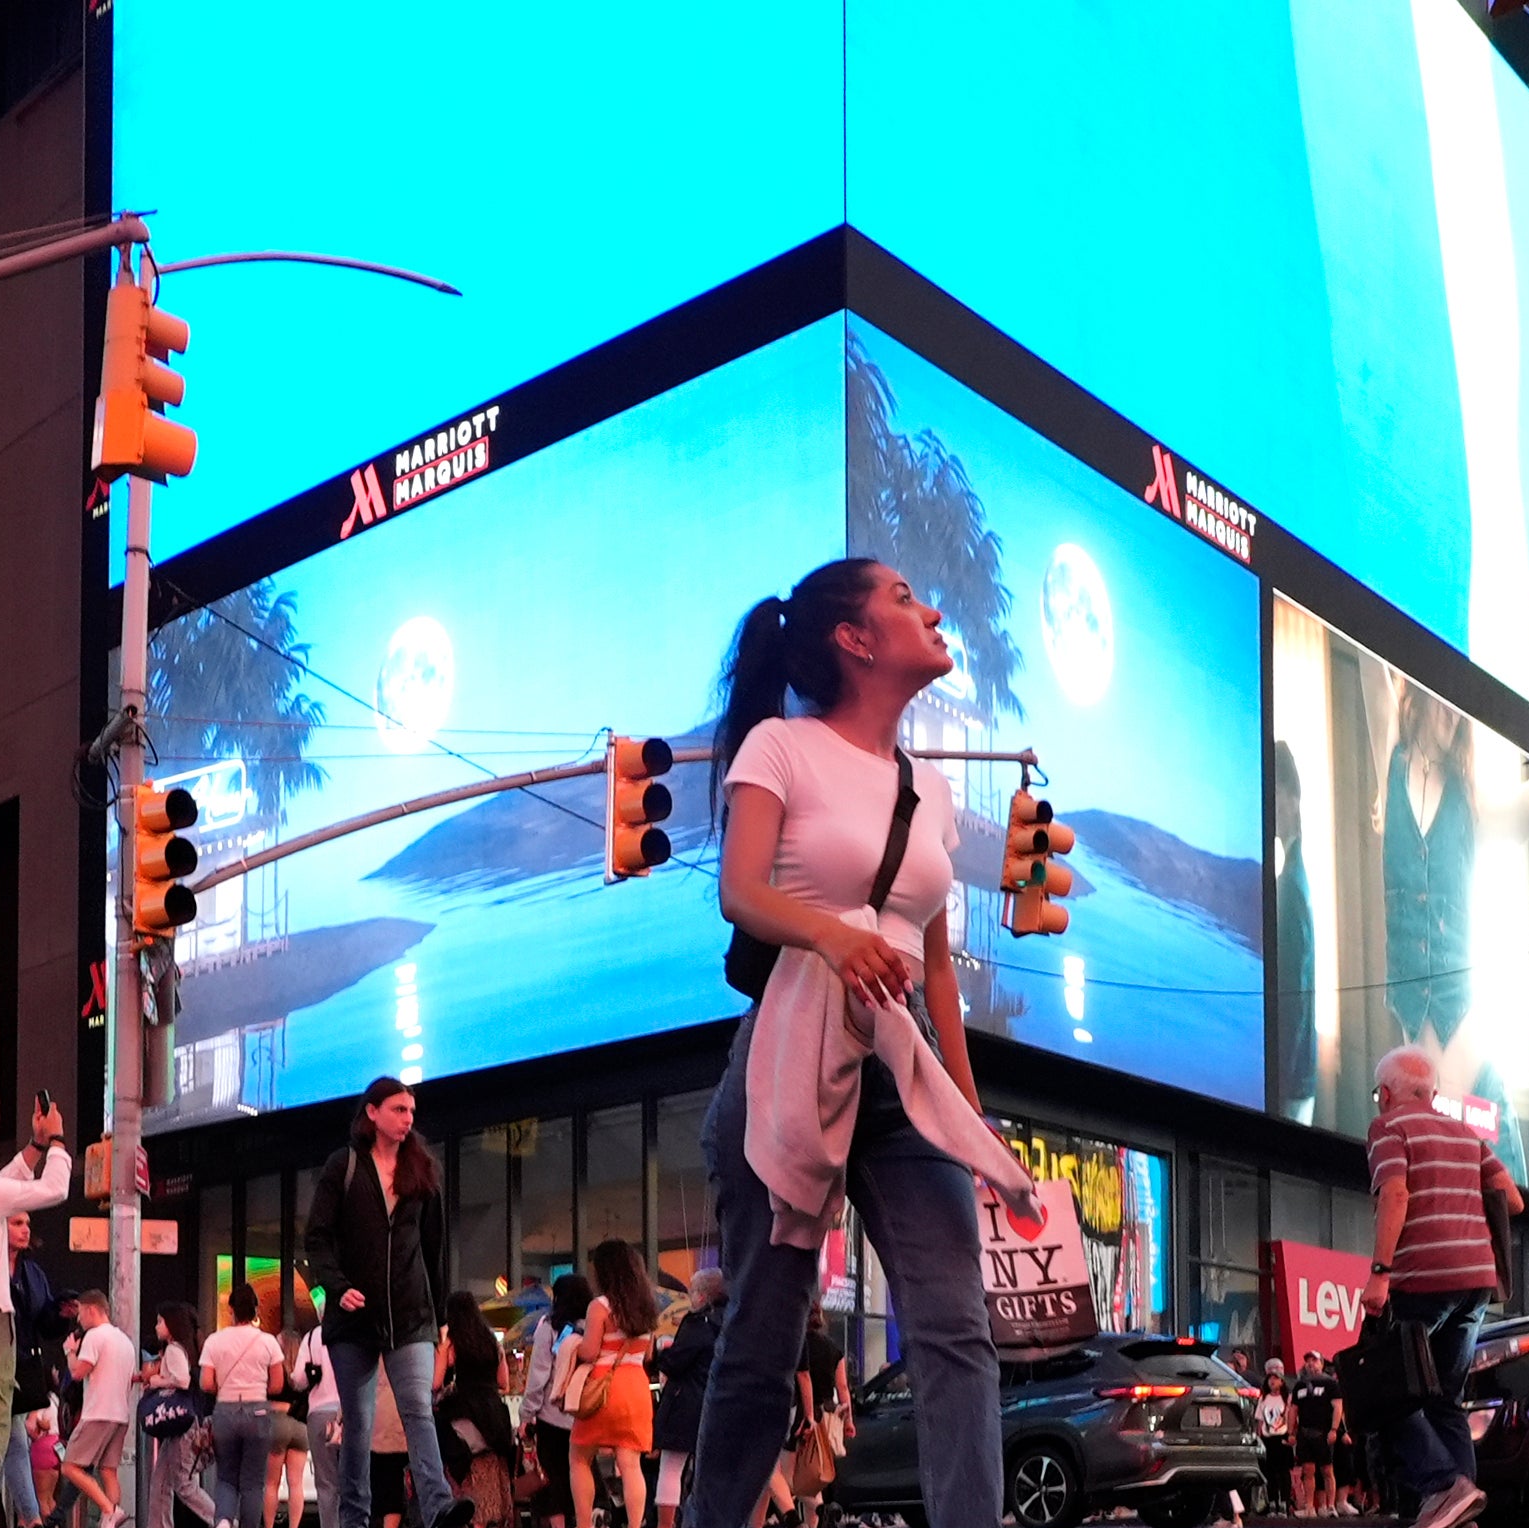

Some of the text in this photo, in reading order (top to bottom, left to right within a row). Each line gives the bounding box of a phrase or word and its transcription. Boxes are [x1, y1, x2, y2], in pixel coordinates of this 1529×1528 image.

[395, 405, 500, 477] MARRIOTT
[396, 442, 486, 506] MARQUIS
[1186, 471, 1257, 537] MARRIOTT
[1187, 499, 1249, 560] MARQUIS
[983, 1202, 1005, 1242] I
[985, 1244, 1063, 1289] NY
[996, 1290, 1077, 1321] GIFTS
[1298, 1277, 1366, 1332] Lev
